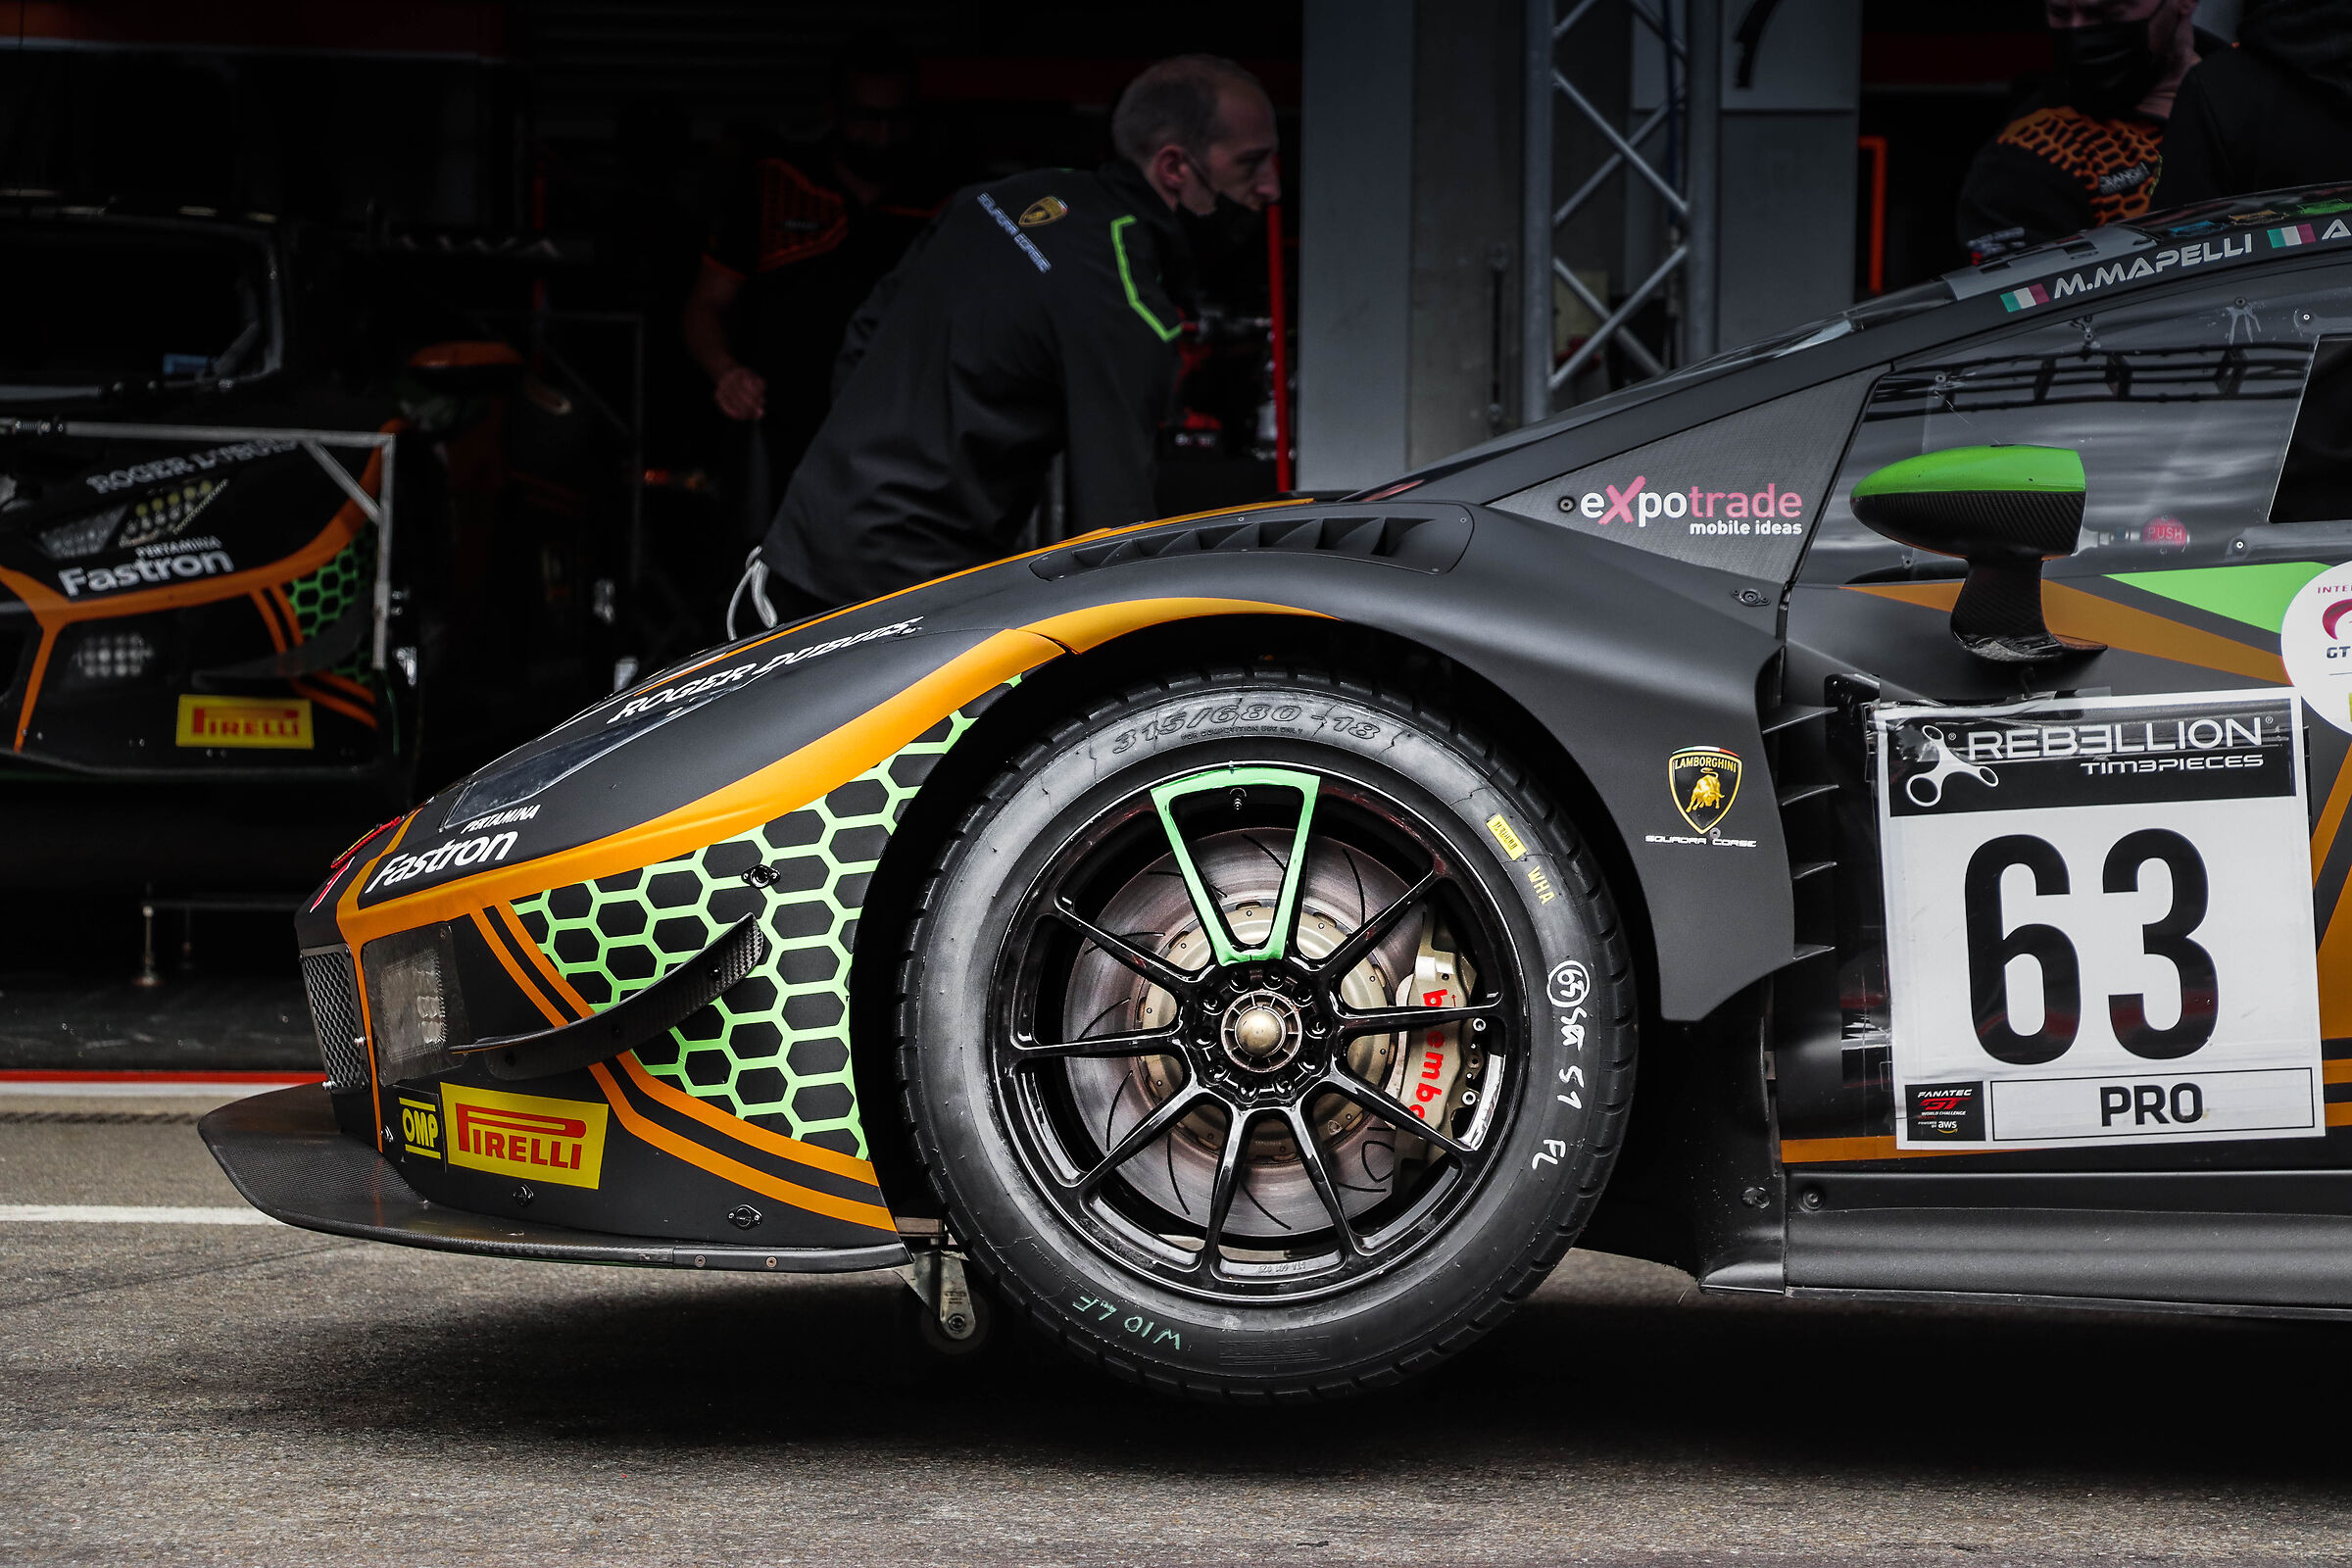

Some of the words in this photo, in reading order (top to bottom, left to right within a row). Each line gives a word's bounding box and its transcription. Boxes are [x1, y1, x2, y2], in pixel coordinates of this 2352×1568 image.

[2054, 232, 2252, 300] M.MAPELLI
[1690, 519, 1750, 536] mobile
[1755, 519, 1803, 536] ideas
[2148, 526, 2182, 540] PUSH
[58, 550, 235, 597] Fastron
[607, 662, 758, 724] ROGER
[192, 707, 299, 737] PIRELLI
[1674, 756, 1738, 773] LAMBORGHINI
[460, 804, 541, 834] PERTAMINA
[364, 830, 518, 894] Fastron
[1644, 835, 1707, 845] SQUADRA
[1712, 837, 1757, 848] CORSE
[1527, 865, 1555, 906] WHA
[1964, 828, 2220, 1065] 63
[1408, 988, 1448, 1120] bembo
[1917, 1088, 1973, 1099] FANATEC
[2100, 1082, 2204, 1127] PRO
[402, 1107, 439, 1148] OMP
[455, 1102, 587, 1170] PIRELLI
[1937, 1120, 1958, 1129] aws
[1532, 1138, 1567, 1170] FL
